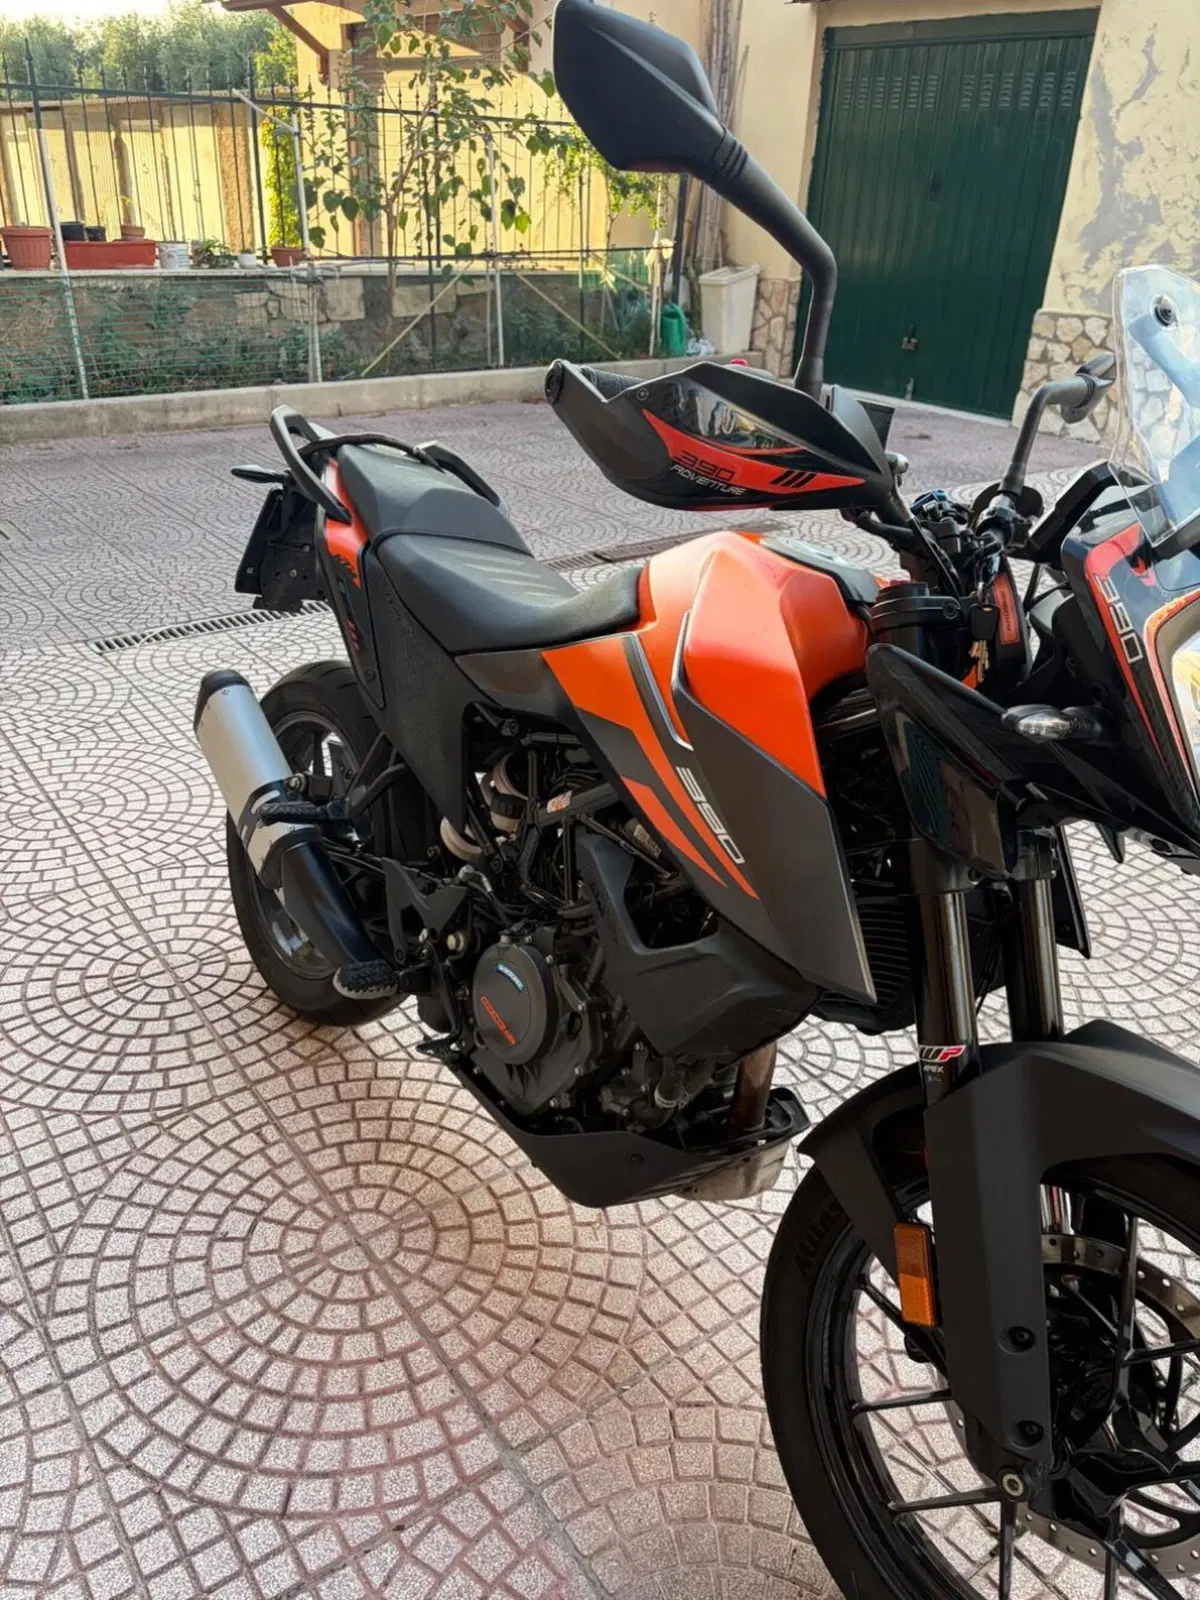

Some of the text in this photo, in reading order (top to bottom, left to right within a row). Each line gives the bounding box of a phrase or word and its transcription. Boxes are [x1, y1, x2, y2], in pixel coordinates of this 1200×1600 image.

[670, 464, 747, 495] ADVENTURE
[674, 449, 737, 482] 390
[1093, 572, 1144, 664] 390
[675, 766, 746, 864] 390
